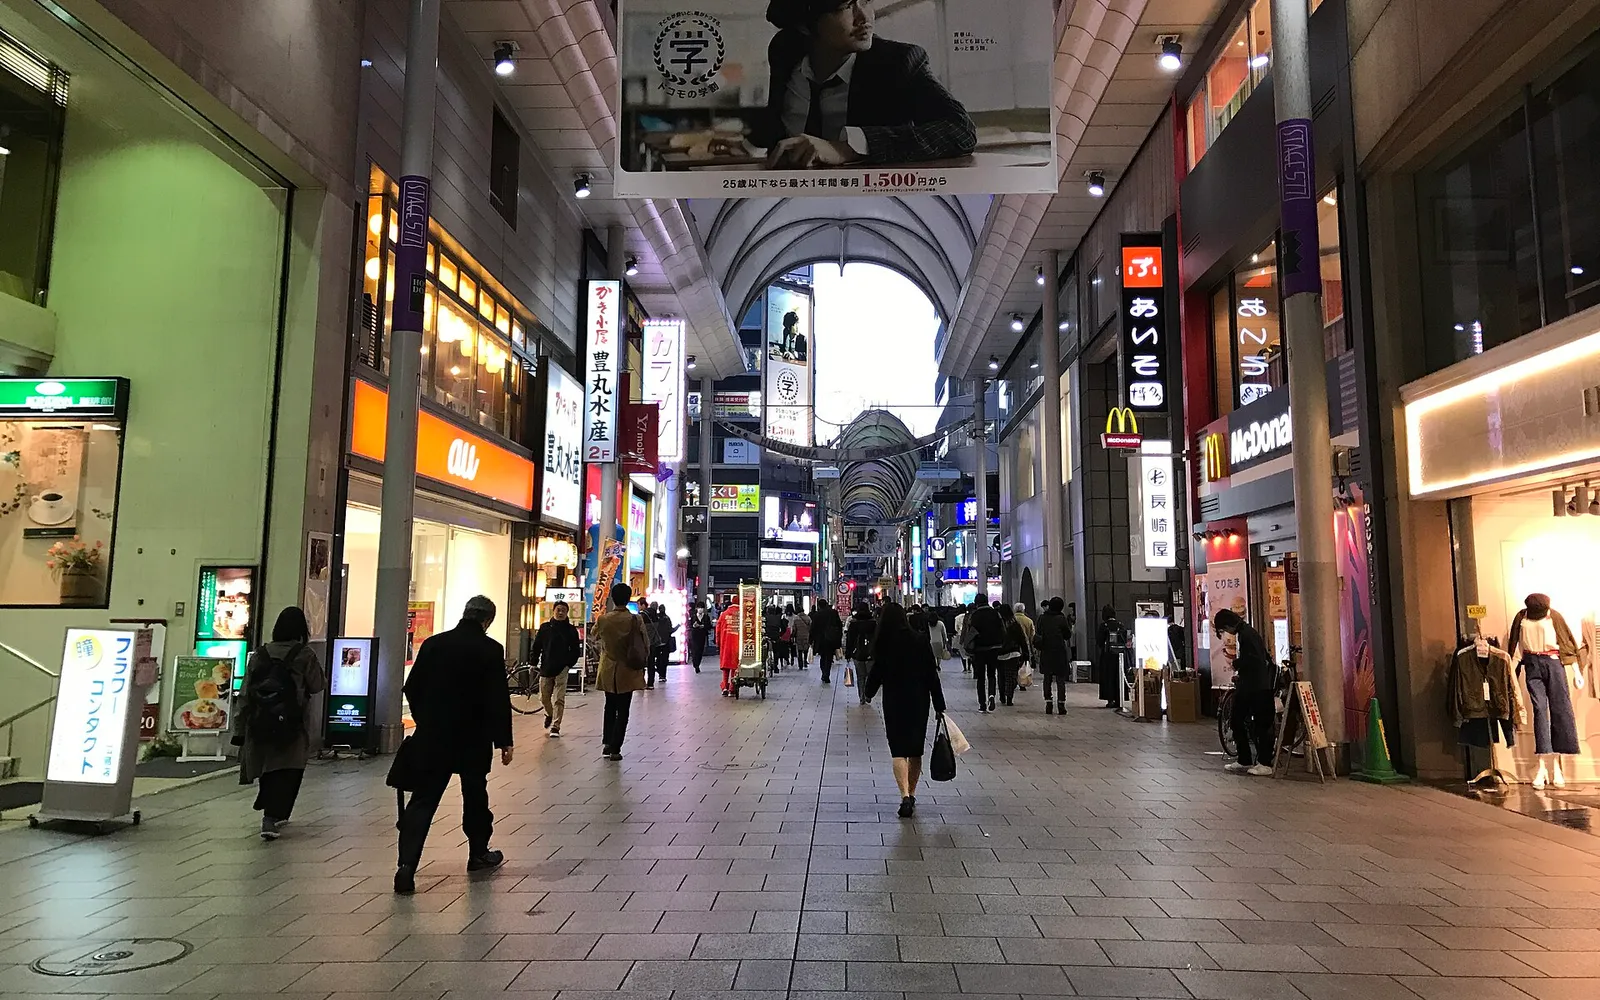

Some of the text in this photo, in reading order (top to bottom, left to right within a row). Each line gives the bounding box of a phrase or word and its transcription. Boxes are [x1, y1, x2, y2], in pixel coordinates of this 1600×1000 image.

[669, 30, 709, 75] 学
[657, 81, 720, 99] ドコモの学割
[594, 286, 613, 346] かき小屋
[587, 350, 613, 443] 豊丸水産
[781, 376, 794, 396] 学
[447, 438, 480, 481] au
[588, 446, 610, 460] 2F
[636, 413, 649, 464] Y!mob
[1151, 494, 1169, 557] 長崎屋
[1214, 577, 1241, 590] てりたま
[112, 637, 131, 714] フラワー
[82, 680, 105, 775] コンタクト
